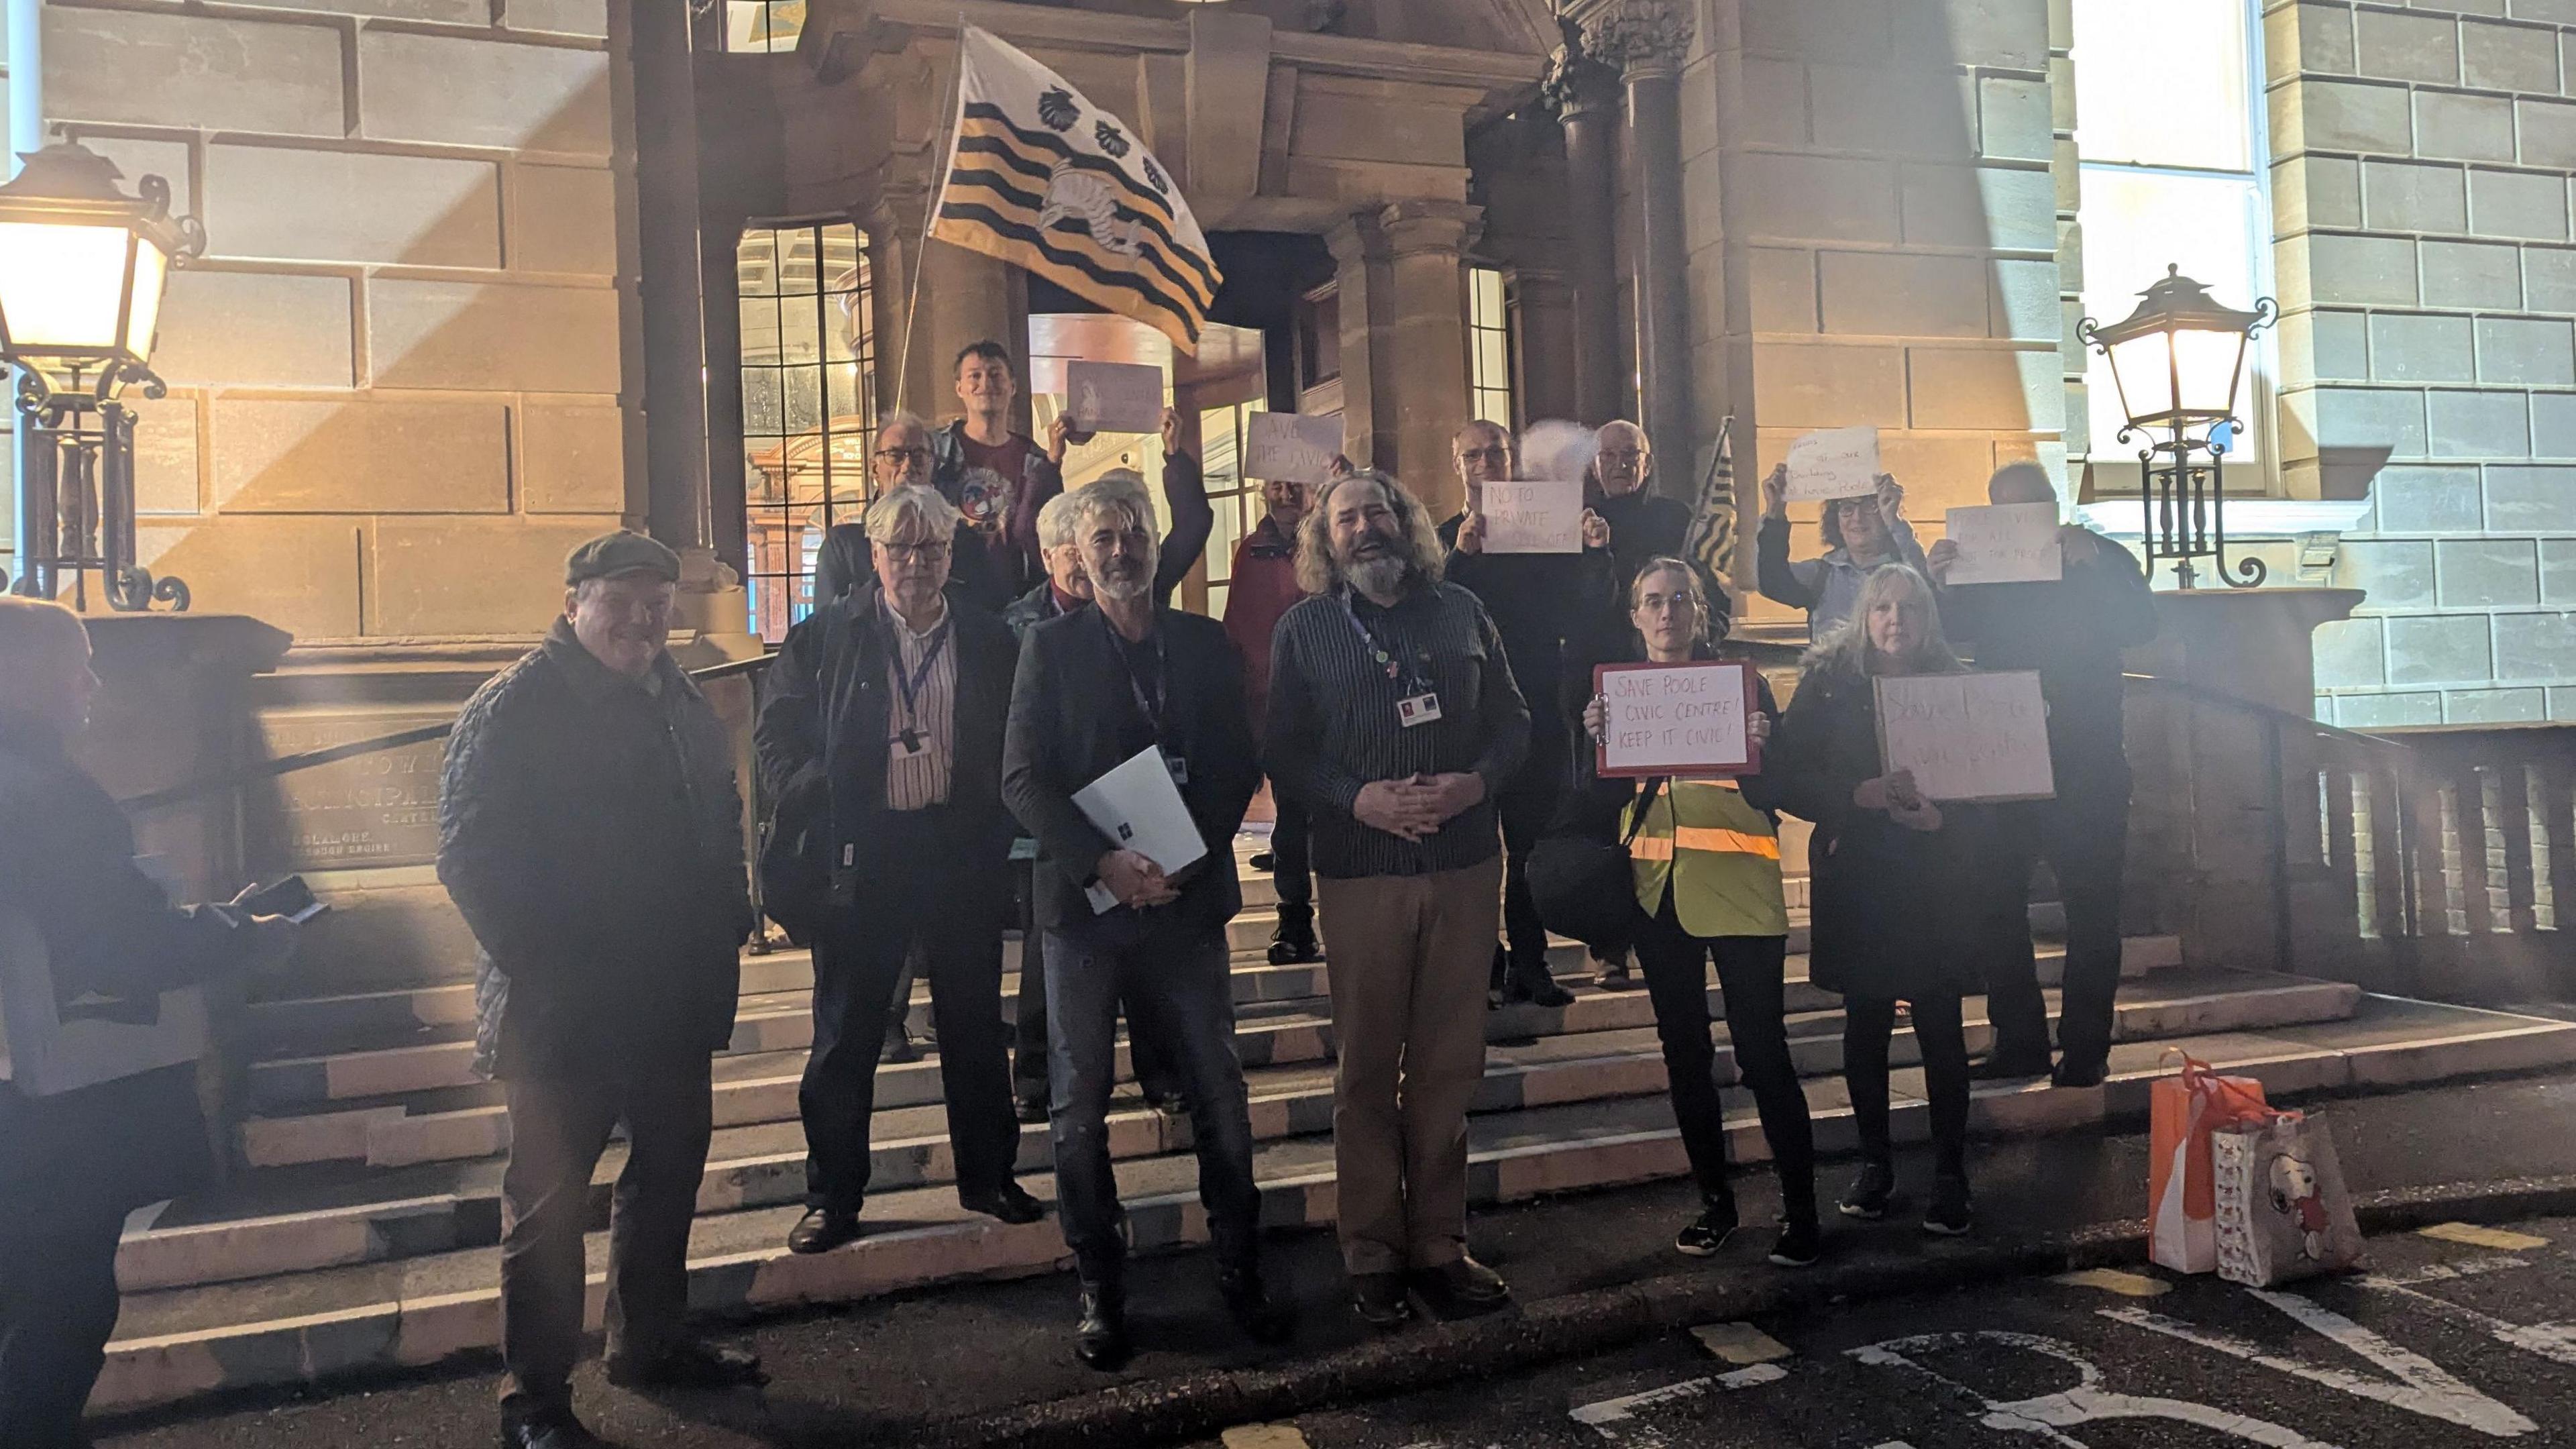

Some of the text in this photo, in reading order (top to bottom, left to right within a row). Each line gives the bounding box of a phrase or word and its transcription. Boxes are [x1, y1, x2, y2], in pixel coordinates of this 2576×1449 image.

[1490, 486, 1534, 504] NO TO
[1495, 509, 1550, 527] PRIVATE
[1615, 675, 1708, 698] SAVE POOLE
[1625, 697, 1740, 722] CIVIC CENTRE!
[1619, 724, 1732, 749] KEEP IT CIVIC!
